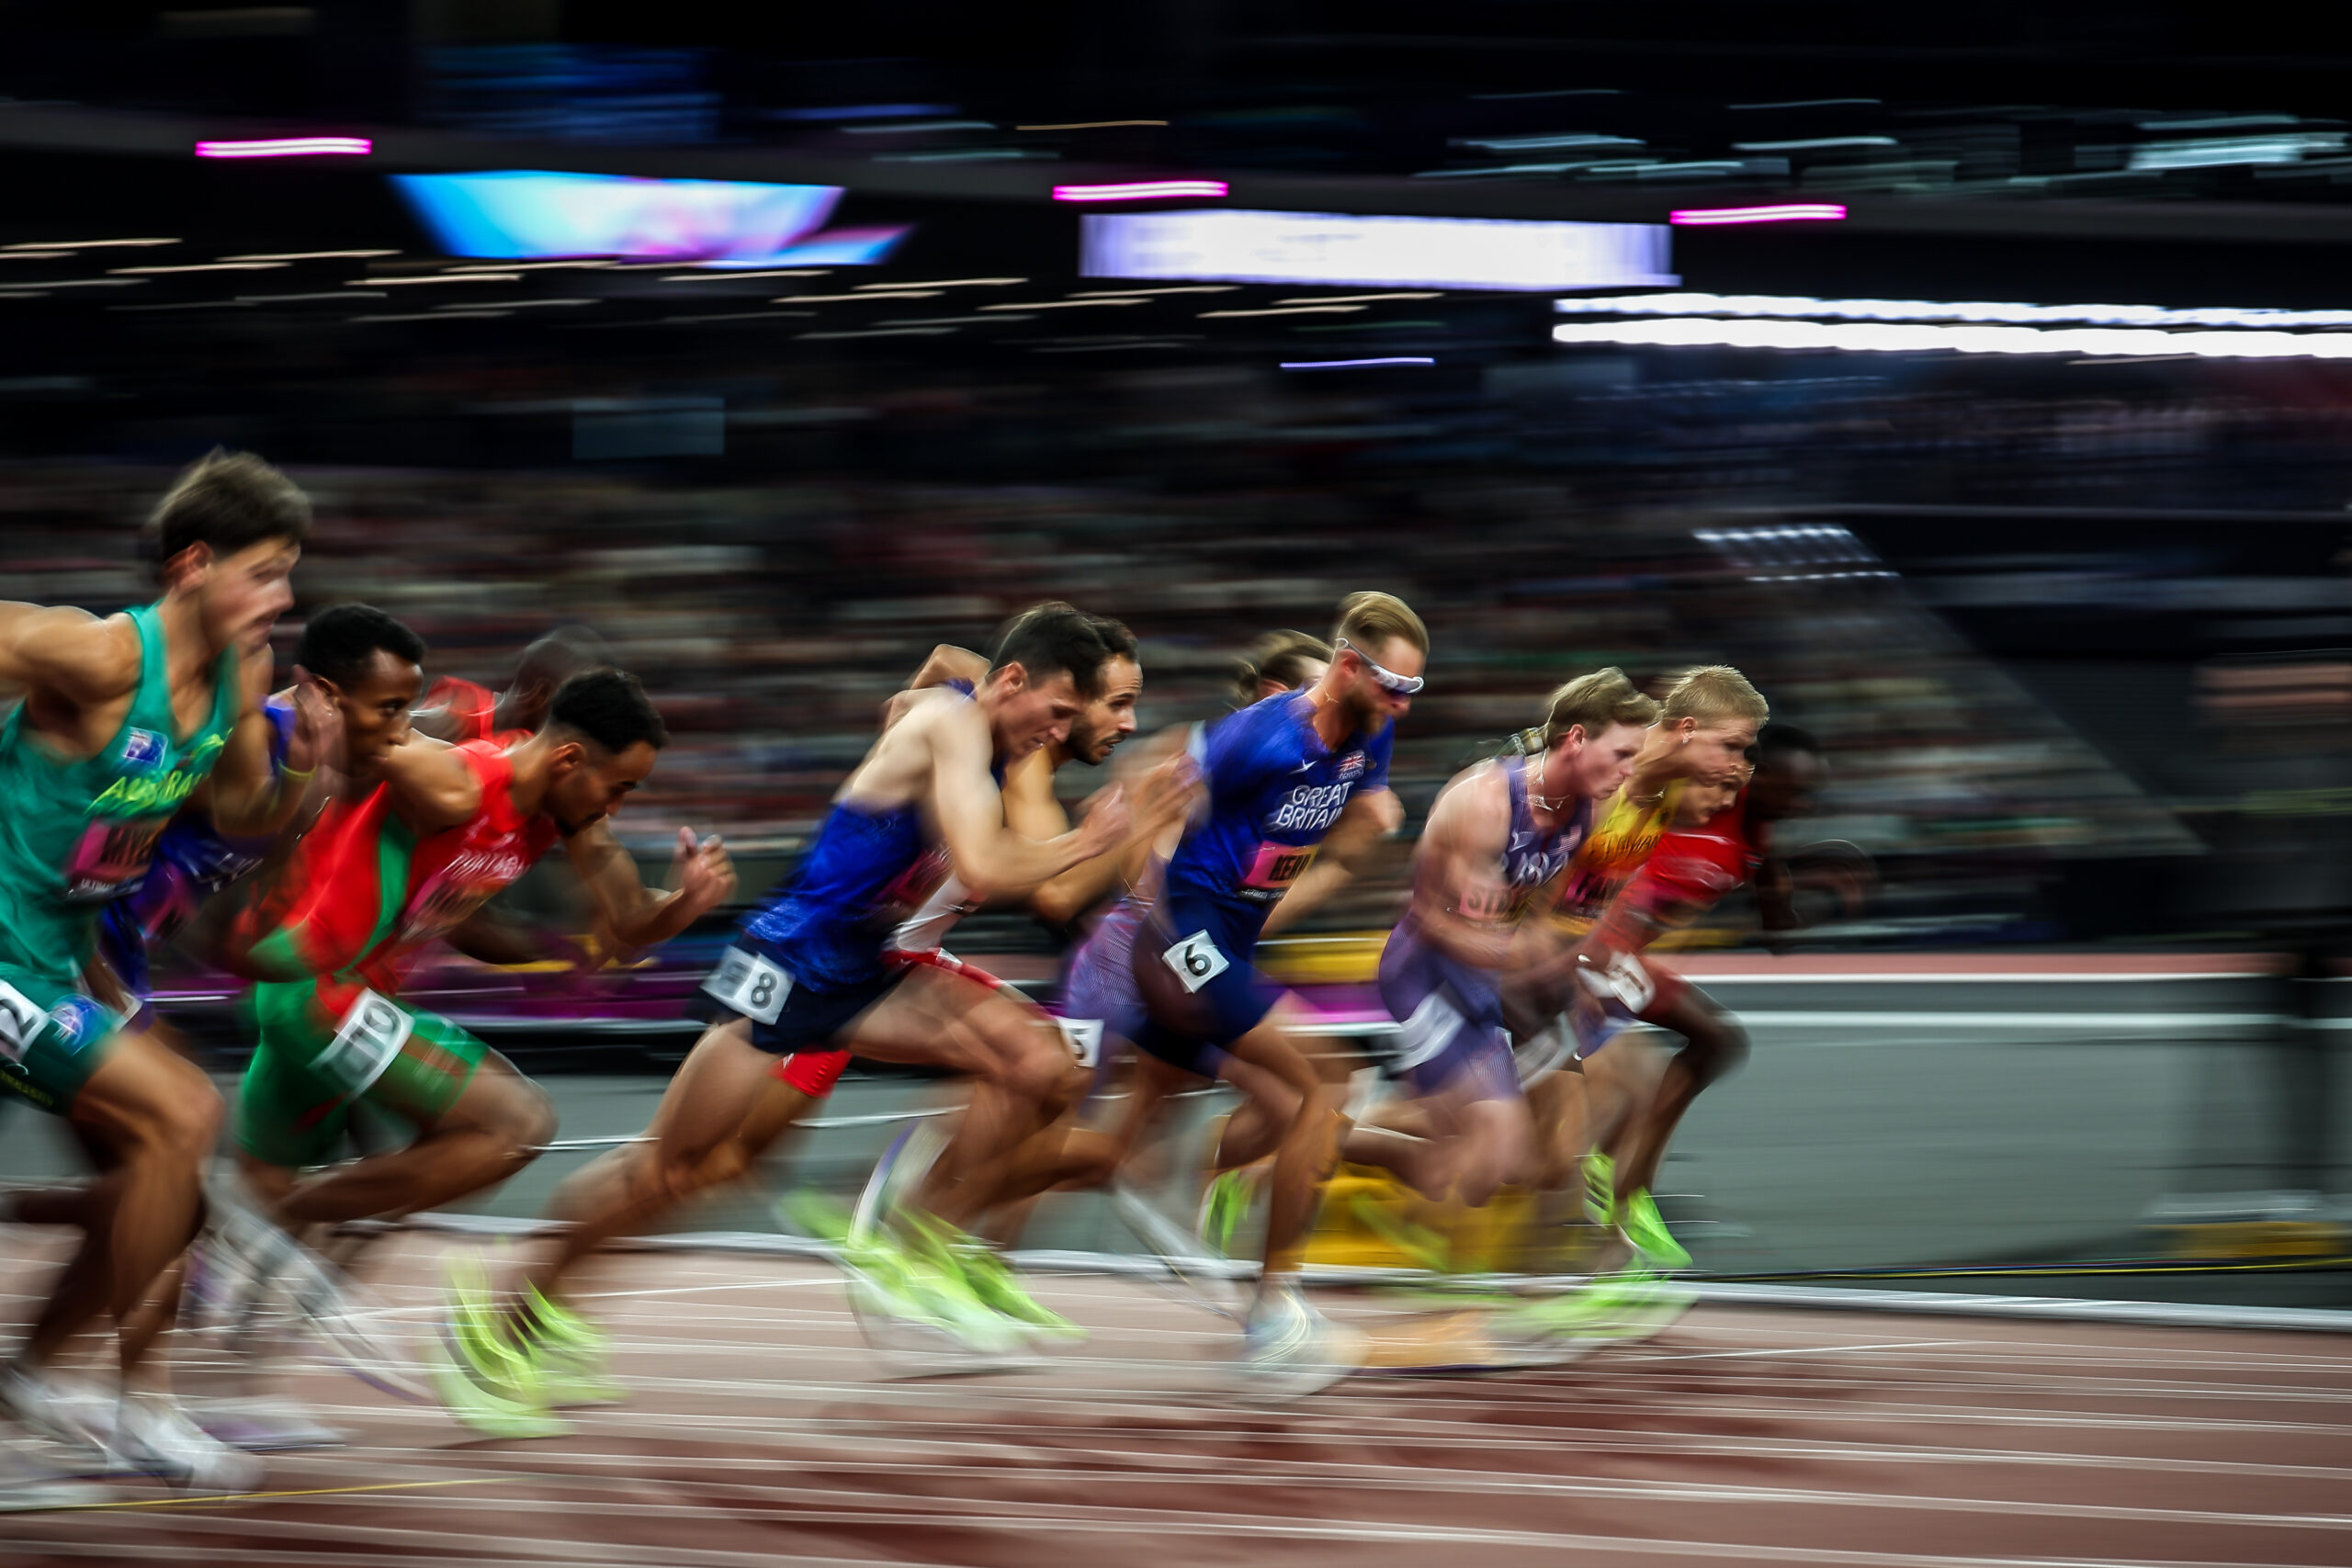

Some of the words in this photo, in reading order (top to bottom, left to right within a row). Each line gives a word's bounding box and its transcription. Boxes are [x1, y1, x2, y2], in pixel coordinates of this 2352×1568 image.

[1291, 781, 1355, 808] GREAT
[1184, 942, 1213, 976] 6
[751, 972, 778, 1010] 8
